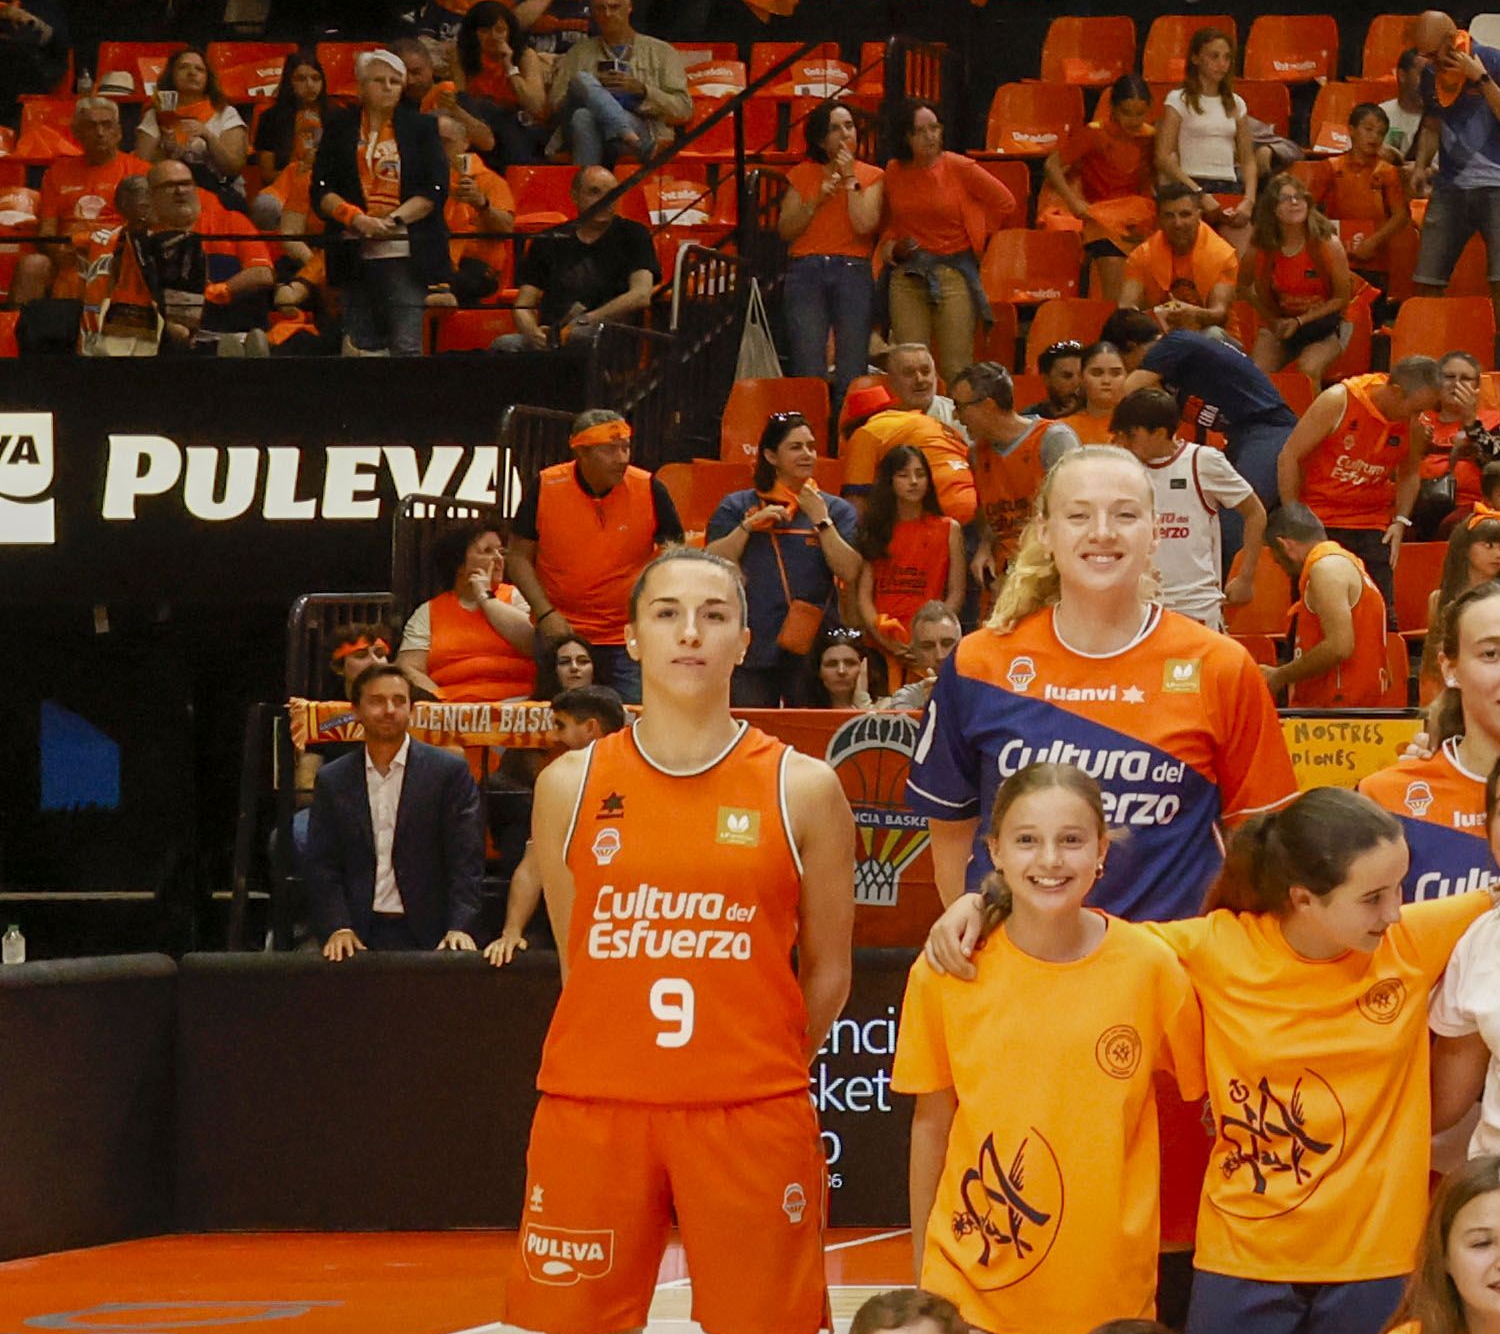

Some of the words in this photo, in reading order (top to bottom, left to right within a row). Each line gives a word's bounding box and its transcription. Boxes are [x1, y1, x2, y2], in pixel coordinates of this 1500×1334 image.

[103, 435, 524, 519] PULEVA
[1044, 683, 1116, 702] luanvi
[415, 704, 493, 732] LENCIA
[497, 705, 554, 732] BASK
[1294, 722, 1384, 745] MOSTRES
[998, 739, 1148, 781] Cultura
[1152, 761, 1183, 784] del
[1101, 792, 1180, 825] erzo
[594, 884, 721, 921] Cultura
[727, 903, 755, 921] del
[587, 921, 751, 961] Esfuerzo
[650, 978, 695, 1048] 9
[525, 1232, 605, 1264] PULEVA
